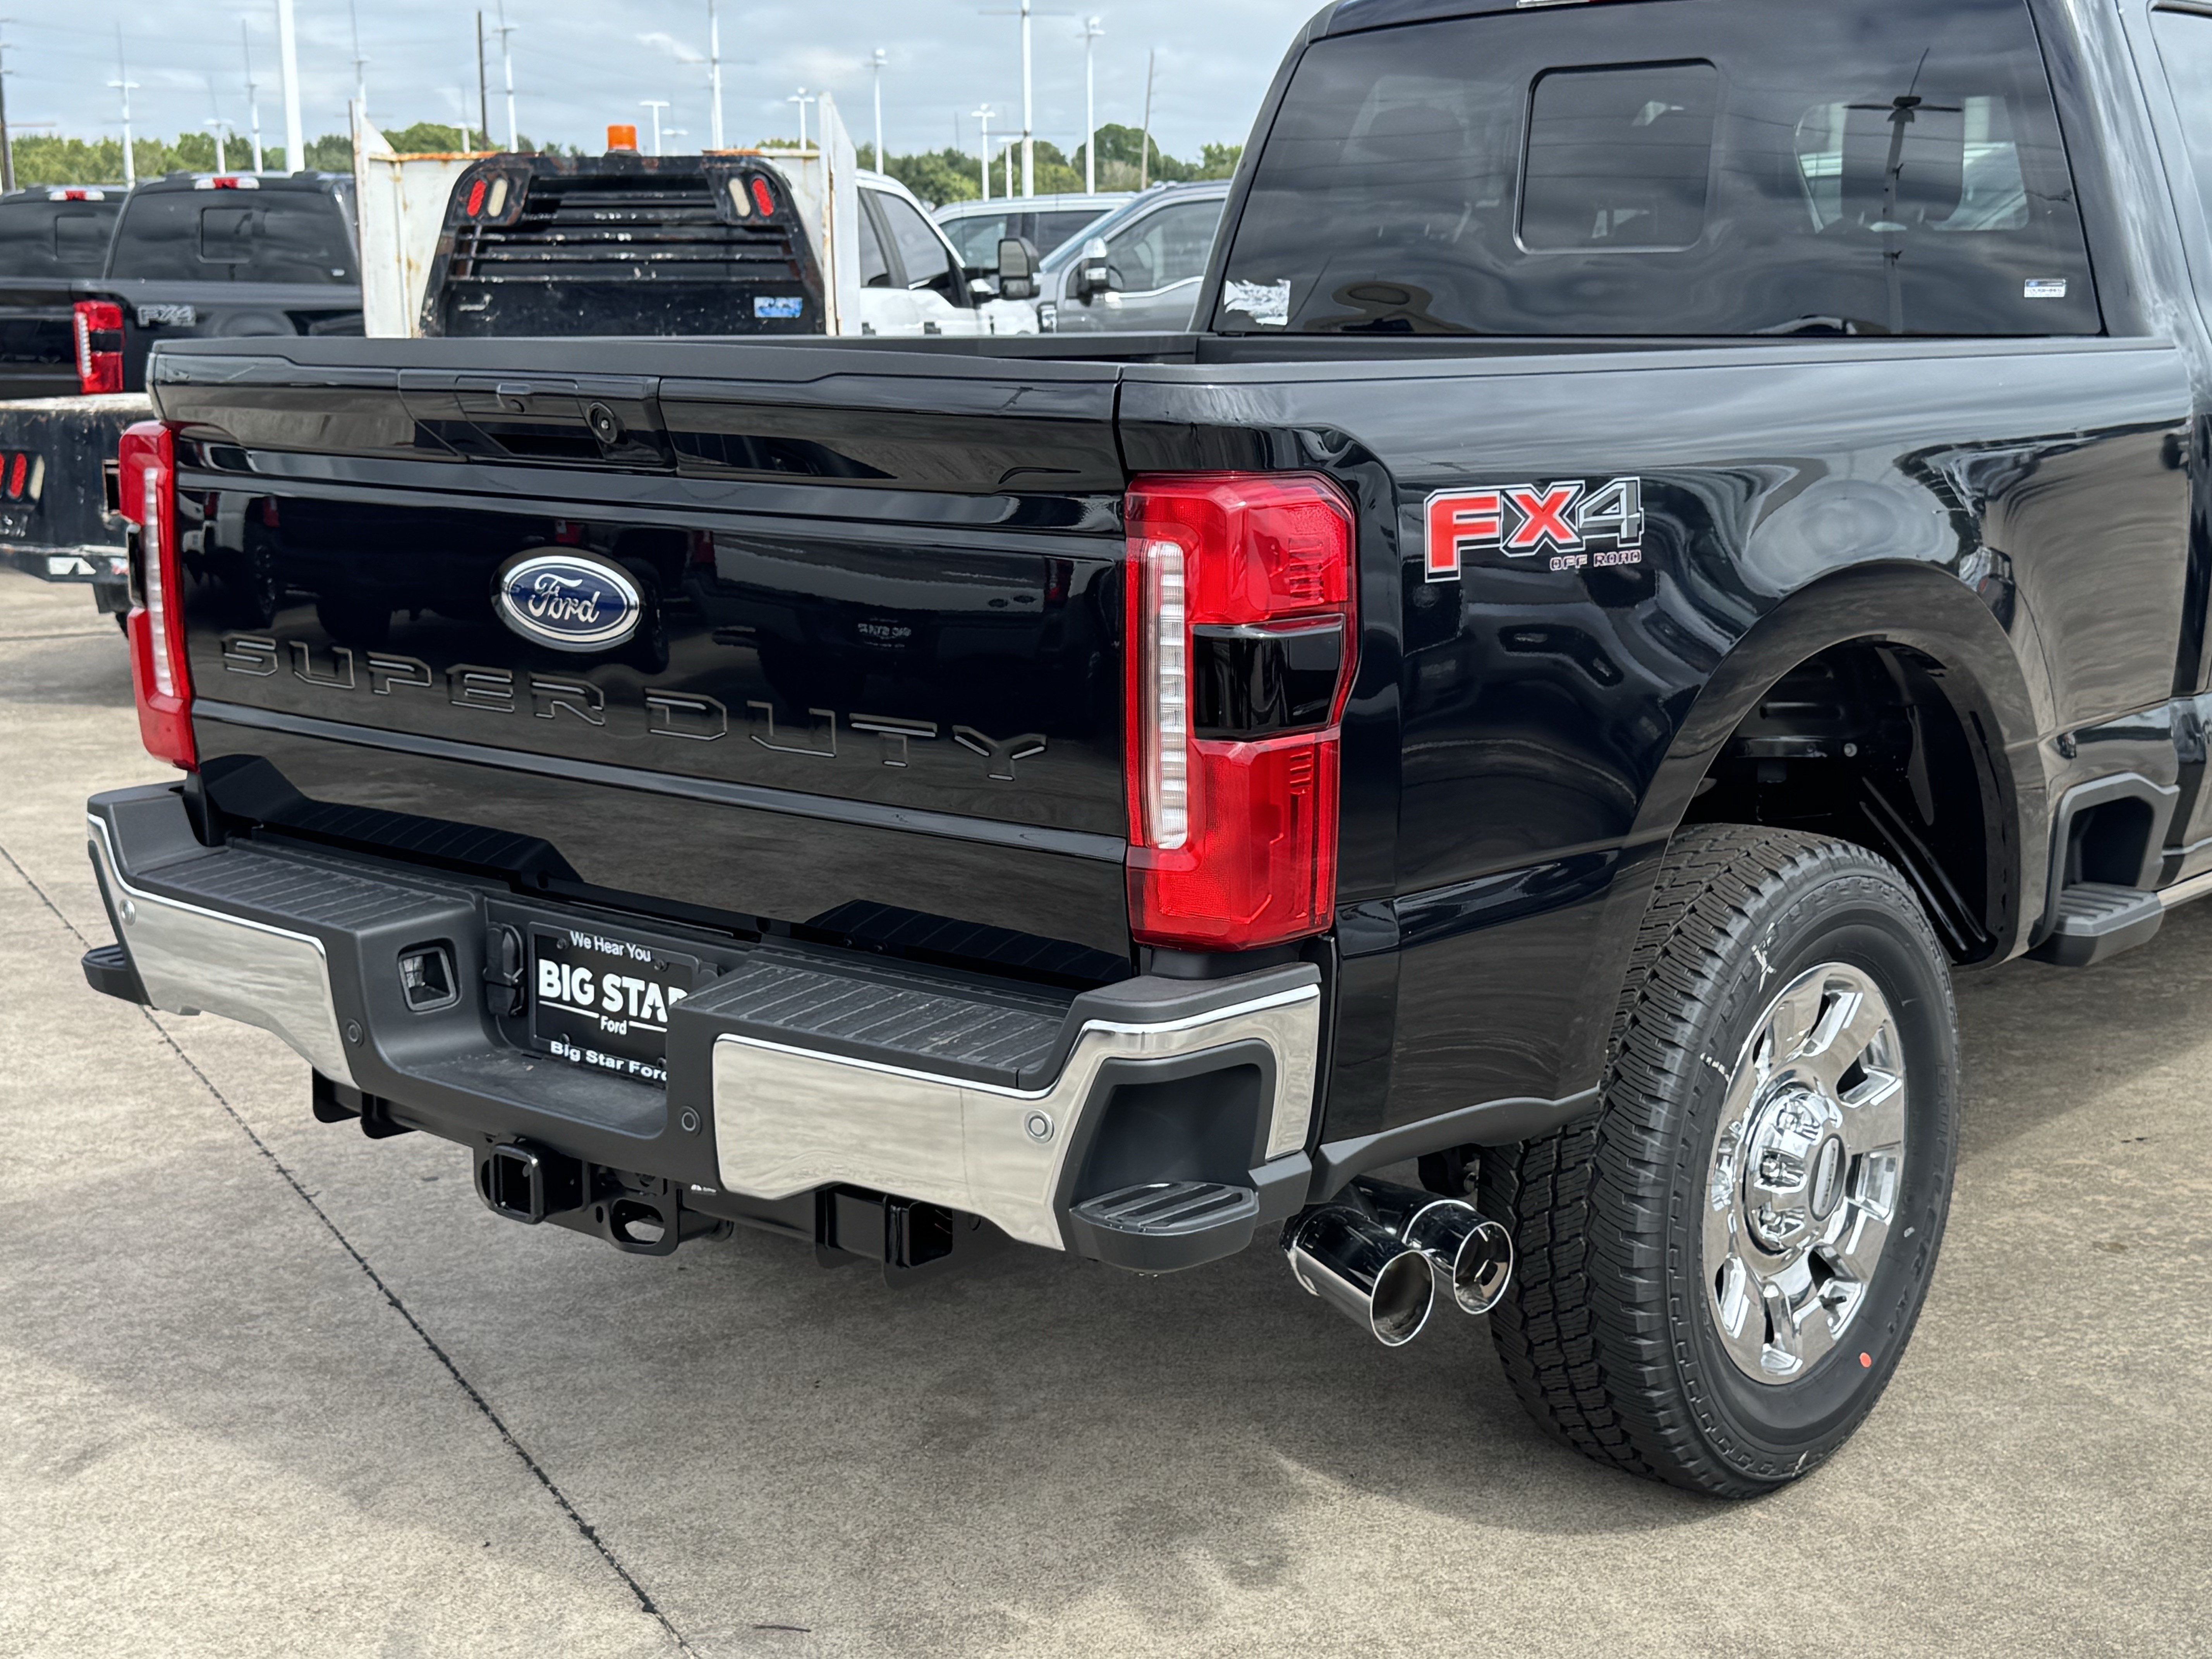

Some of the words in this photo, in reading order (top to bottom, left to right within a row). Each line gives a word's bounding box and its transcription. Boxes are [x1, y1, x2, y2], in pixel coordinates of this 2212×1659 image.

[1424, 476, 1644, 583] FX4
[1550, 554, 1587, 571] OFF
[1594, 549, 1642, 568] ROAD
[528, 573, 601, 623] Ford
[222, 632, 606, 727] SUPER
[644, 687, 1048, 781] DUTY
[570, 930, 592, 949] We
[593, 936, 624, 957] Hear
[626, 943, 651, 962] You
[538, 959, 595, 1005] BIG
[600, 1015, 627, 1035] Ford
[550, 1040, 581, 1062] Big
[586, 1049, 624, 1070] Star
